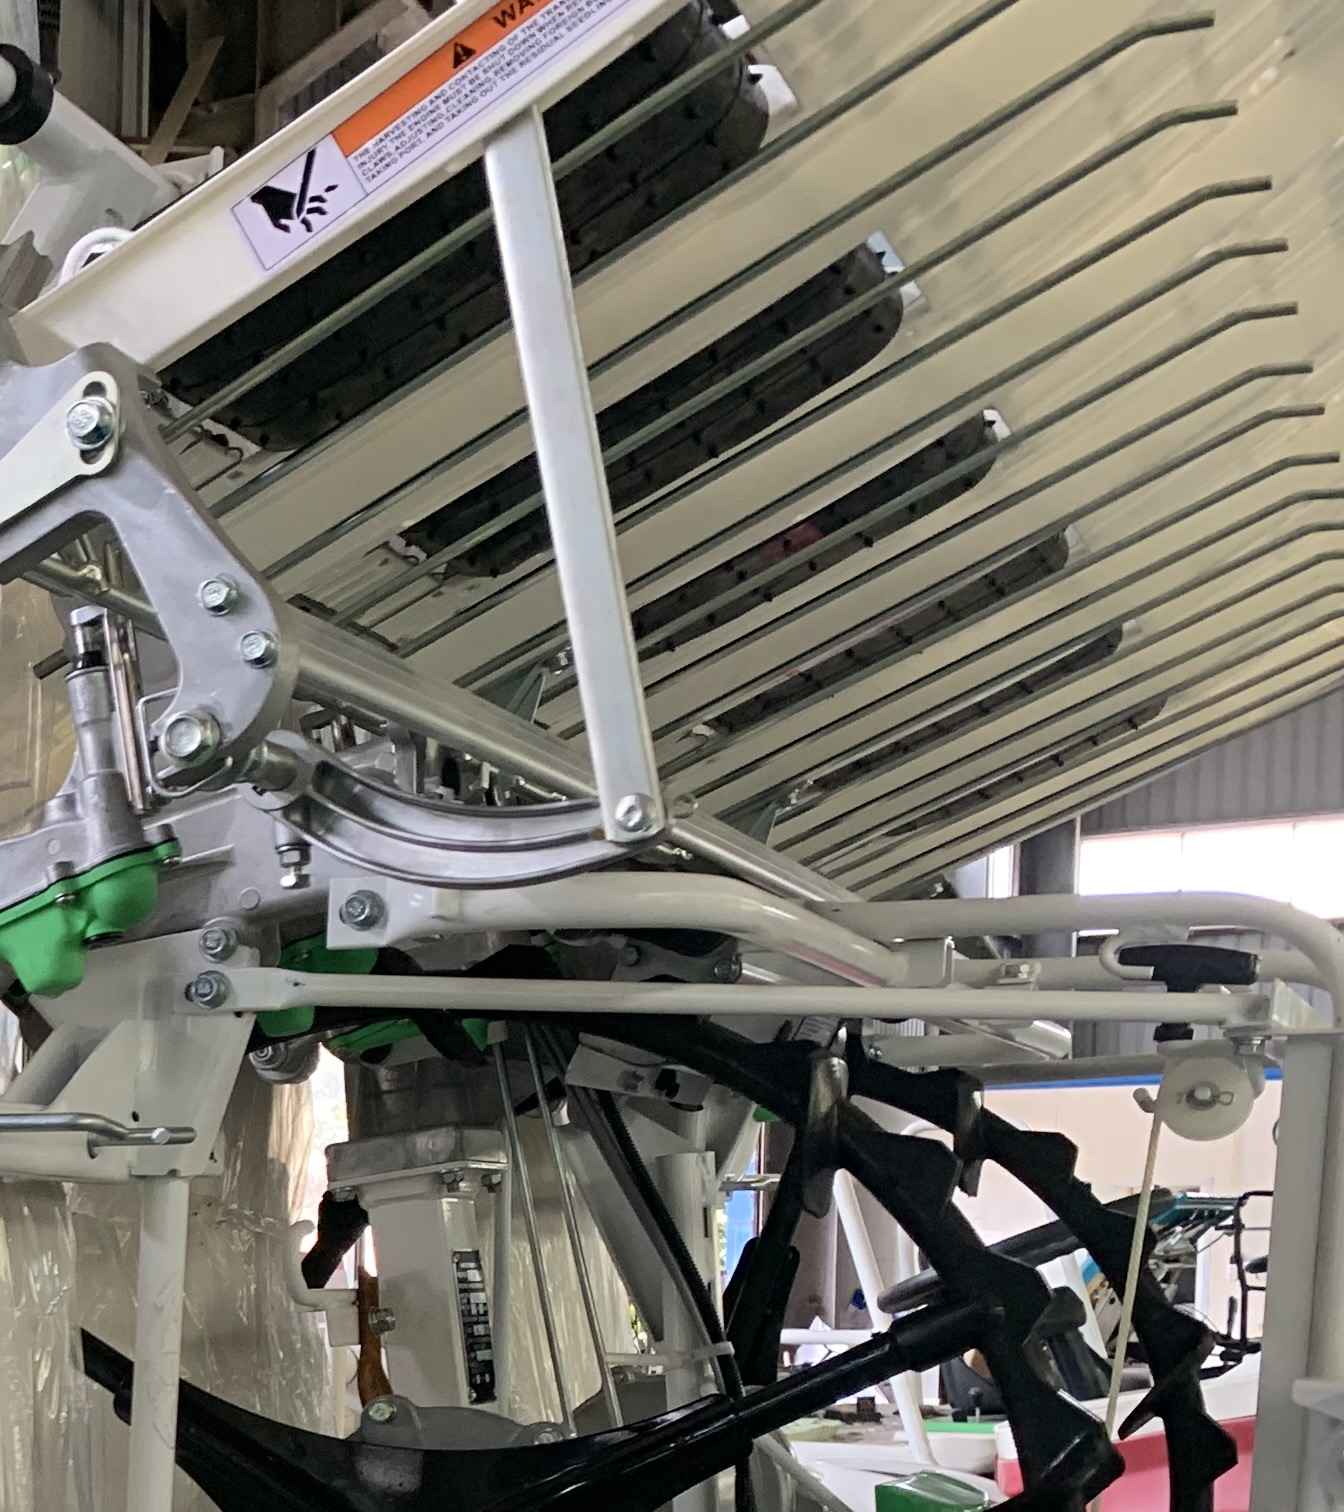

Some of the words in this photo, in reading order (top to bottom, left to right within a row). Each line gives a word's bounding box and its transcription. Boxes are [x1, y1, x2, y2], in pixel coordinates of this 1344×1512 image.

[357, 143, 388, 168] INJURY
[390, 130, 405, 143] THE
[408, 103, 441, 130] ENGINE
[442, 83, 467, 104] MUST
[468, 73, 481, 85] BE
[482, 54, 506, 74] SHUT
[507, 31, 536, 55] DOWN
[537, 10, 564, 33] WHEN
[366, 156, 398, 182] TAKING
[425, 121, 445, 138] AND
[445, 96, 479, 123] TAKING
[480, 81, 498, 97] OUT
[519, 32, 563, 67] RESIDUAL
[371, 103, 427, 148] HARVESTING
[428, 88, 447, 104] AND
[448, 44, 506, 90] CONTACTING
[507, 34, 520, 45] OF
[521, 21, 537, 34] THE
[493, 38, 541, 76] REMOVING
[543, 5, 584, 38] FOREIGN
